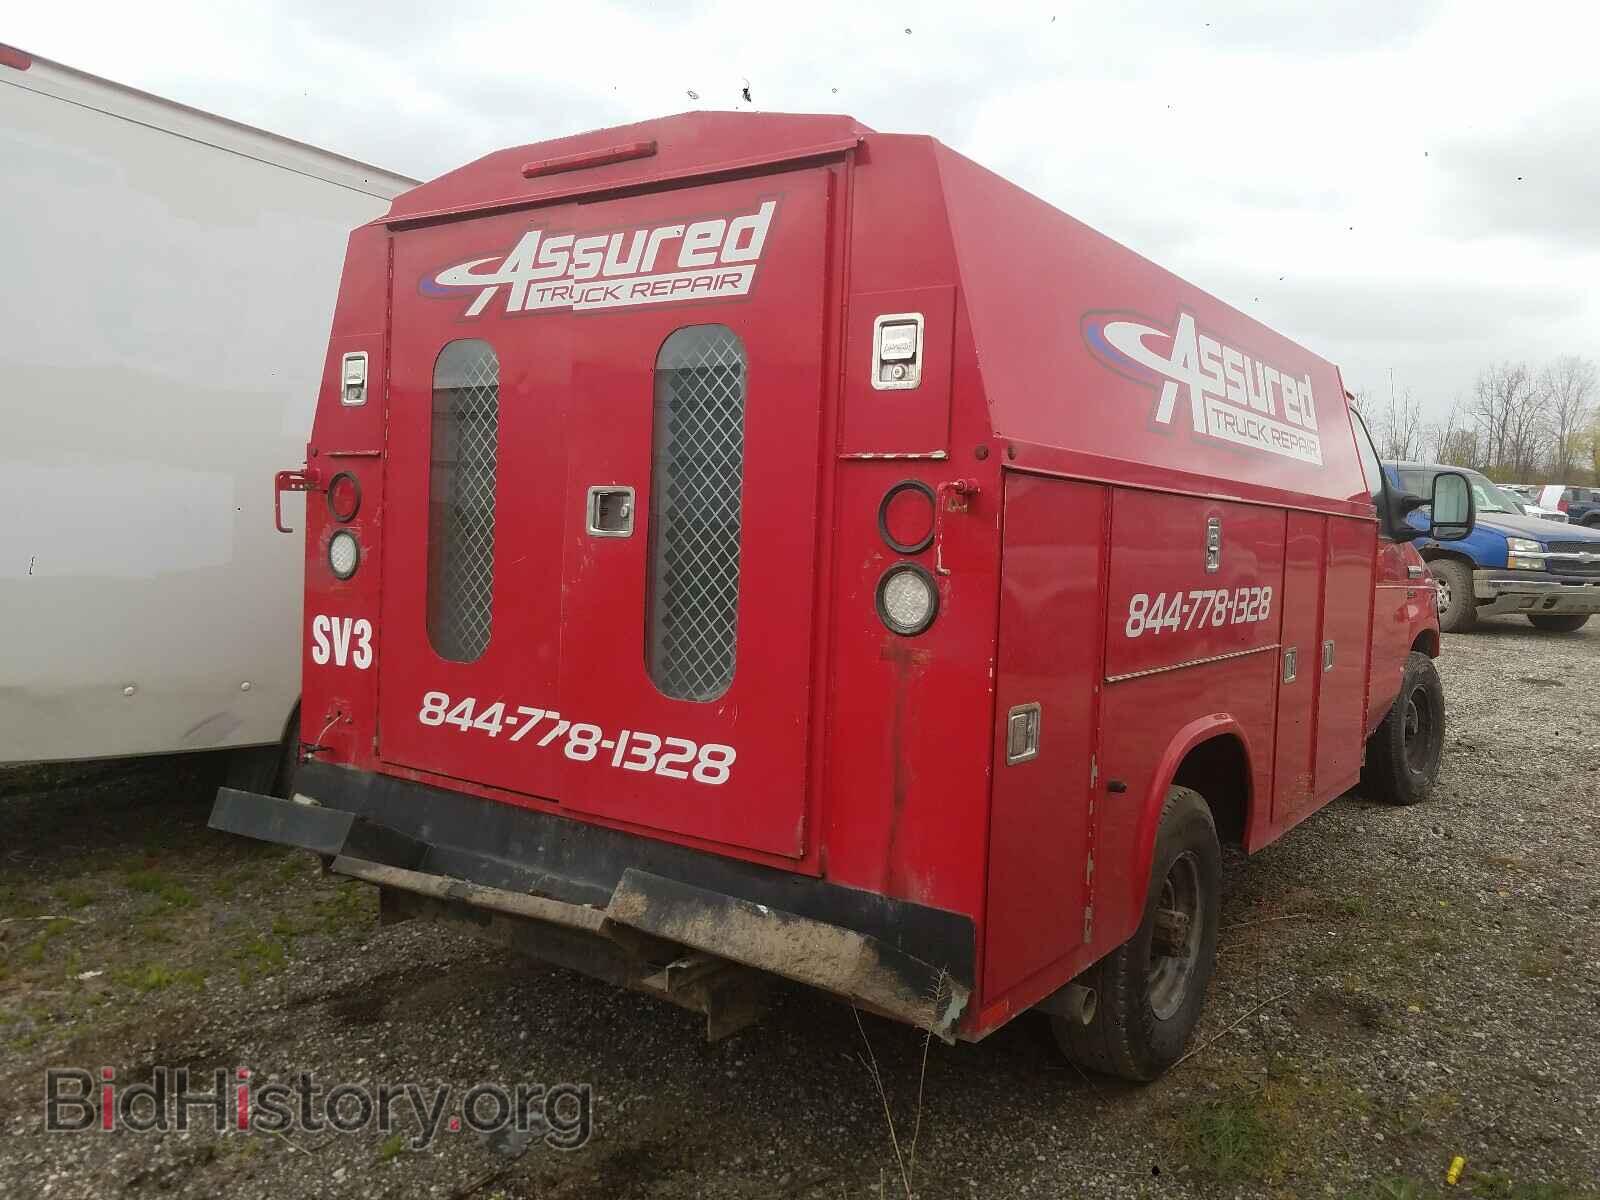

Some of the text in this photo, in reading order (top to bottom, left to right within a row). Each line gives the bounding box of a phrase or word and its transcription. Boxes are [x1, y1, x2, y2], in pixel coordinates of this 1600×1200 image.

[435, 201, 777, 316] Assured
[535, 272, 744, 304] TRUCK REPAIR
[1104, 312, 1318, 434] Assured
[1212, 408, 1318, 456] TRUCK REPAIR
[1125, 586, 1273, 638] 844-778-1328
[312, 614, 373, 670] SV3
[419, 691, 737, 785] 844-778-1328
